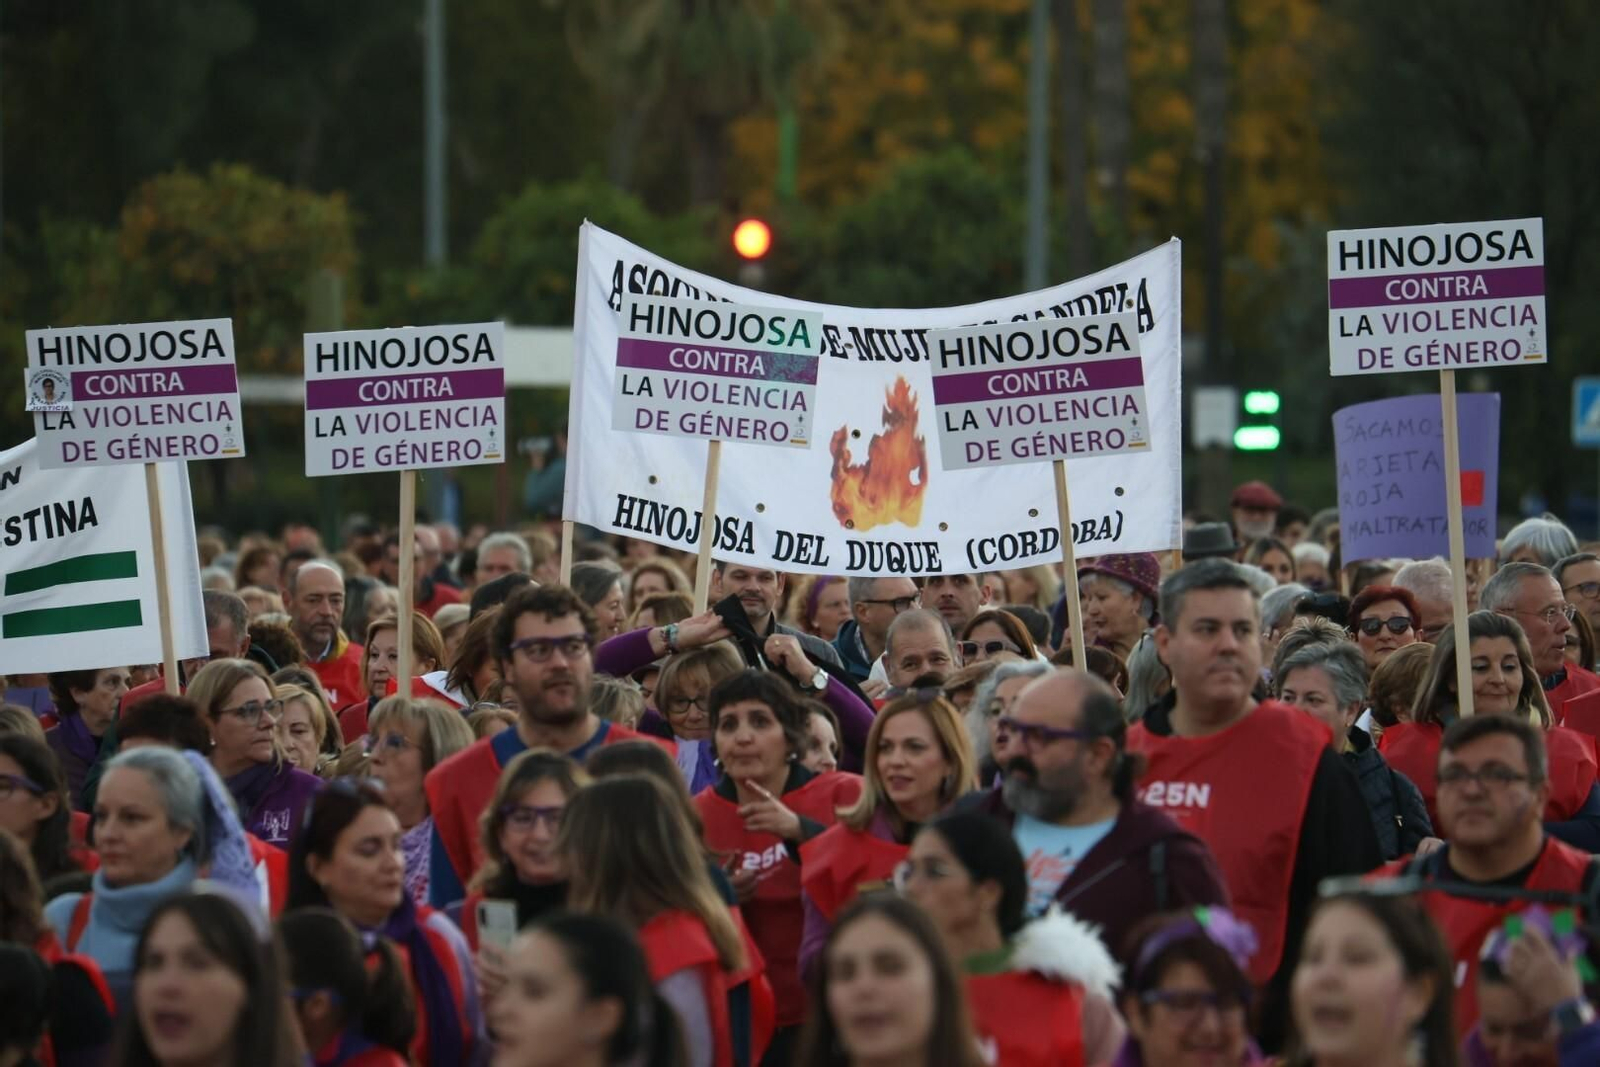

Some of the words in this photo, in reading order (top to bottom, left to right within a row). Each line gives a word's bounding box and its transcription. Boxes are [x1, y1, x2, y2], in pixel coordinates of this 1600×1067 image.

[1339, 229, 1534, 271] HINOJOSA
[1385, 274, 1488, 301] CONTRA
[629, 303, 811, 348] HINOJOSA
[1339, 314, 1374, 338] LA
[1382, 304, 1538, 335] VIOLENCIA
[38, 328, 226, 366] HINOJOSA
[316, 332, 495, 373] HINOJOSA
[669, 347, 765, 376] CONTRA
[939, 322, 1131, 368] HINOJOSA
[1358, 347, 1394, 370] DE
[1404, 338, 1521, 367] GÉNERO
[85, 371, 185, 396] CONTRA
[358, 376, 453, 402] CONTRA
[621, 374, 654, 397] LA
[663, 377, 807, 412] VIOLENCIA
[987, 367, 1089, 395] CONTRA
[43, 411, 76, 430] LA
[83, 400, 234, 428] VIOLENCIA
[315, 415, 347, 438] LA
[355, 404, 497, 435] VIOLENCIA
[635, 407, 670, 431] DE
[679, 410, 789, 442] GÉNERO
[945, 409, 979, 432] LA
[986, 394, 1140, 428] VIOLENCIA
[62, 440, 98, 463] DE
[107, 433, 219, 460] GÉNERO
[332, 446, 365, 470] DE
[375, 439, 482, 467] GÉNERO
[965, 439, 1002, 463] DE
[1011, 428, 1125, 458] GÉNERO
[0, 496, 98, 547] STINA
[771, 530, 830, 567] DEL
[845, 539, 942, 573] DUQUE
